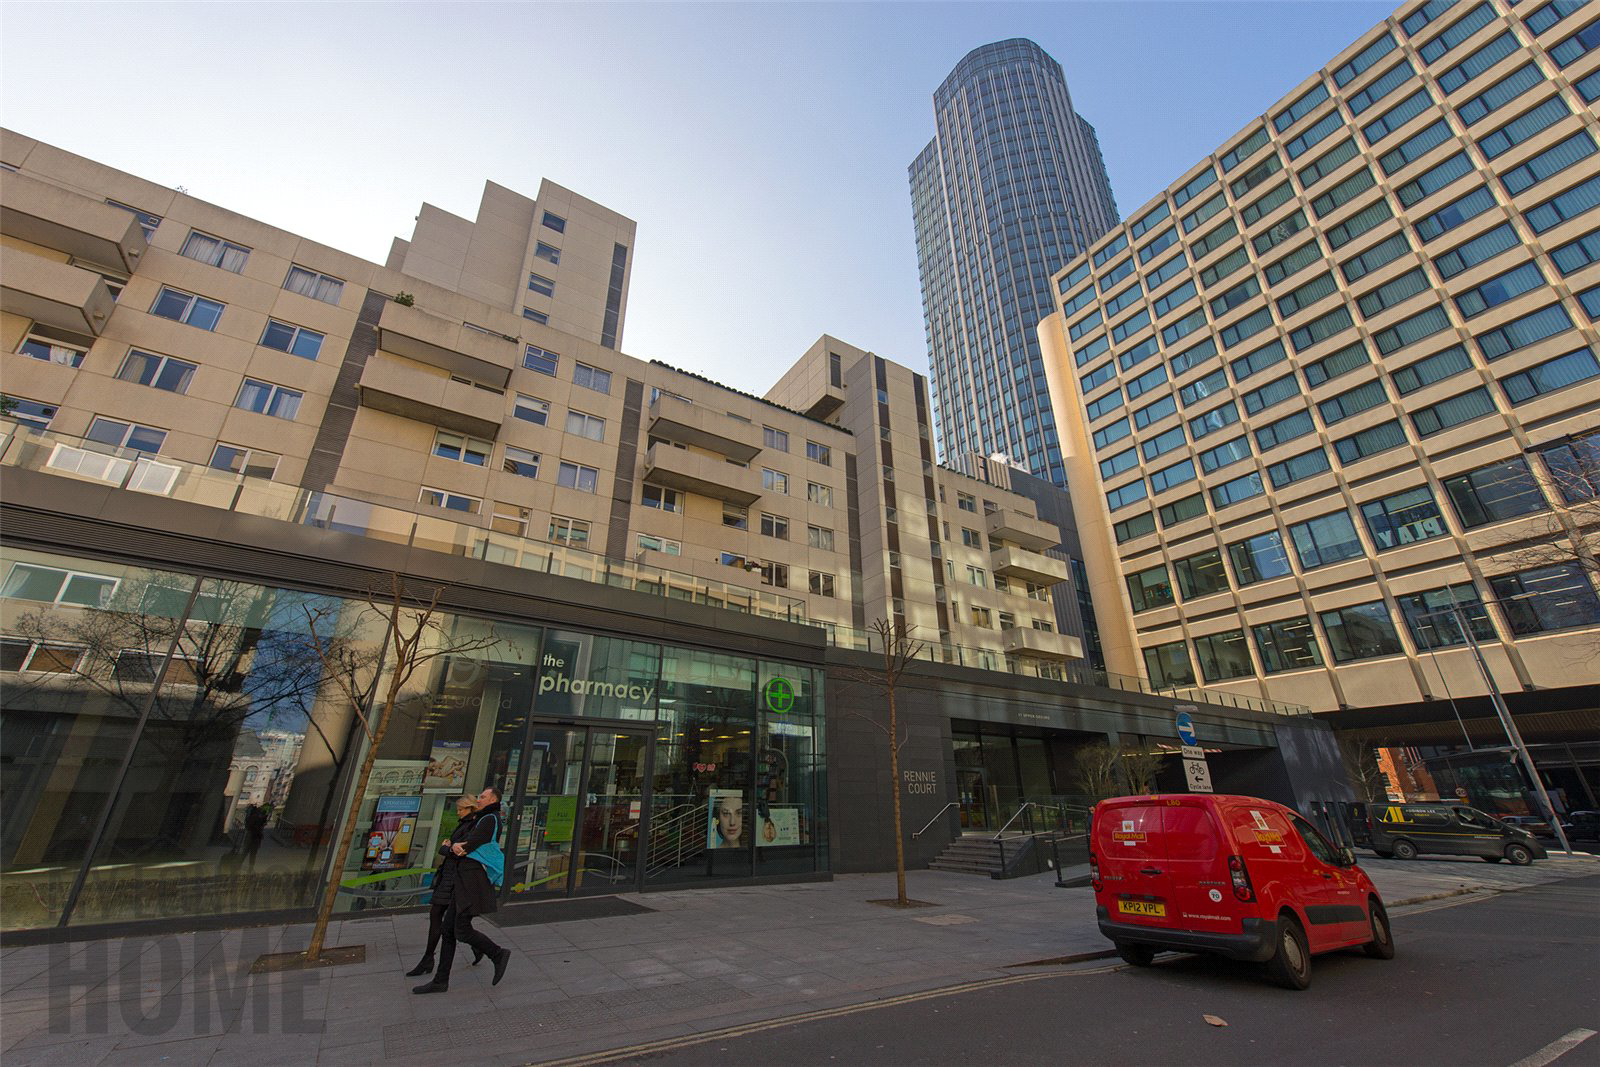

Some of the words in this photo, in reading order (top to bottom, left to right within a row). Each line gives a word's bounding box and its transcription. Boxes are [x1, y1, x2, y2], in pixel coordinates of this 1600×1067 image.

[543, 653, 565, 668] the
[538, 672, 655, 705] pharmacy
[903, 770, 937, 782] RENNIE
[908, 783, 937, 795] COURT
[1123, 901, 1141, 912] KP12
[1143, 903, 1160, 914] VPL
